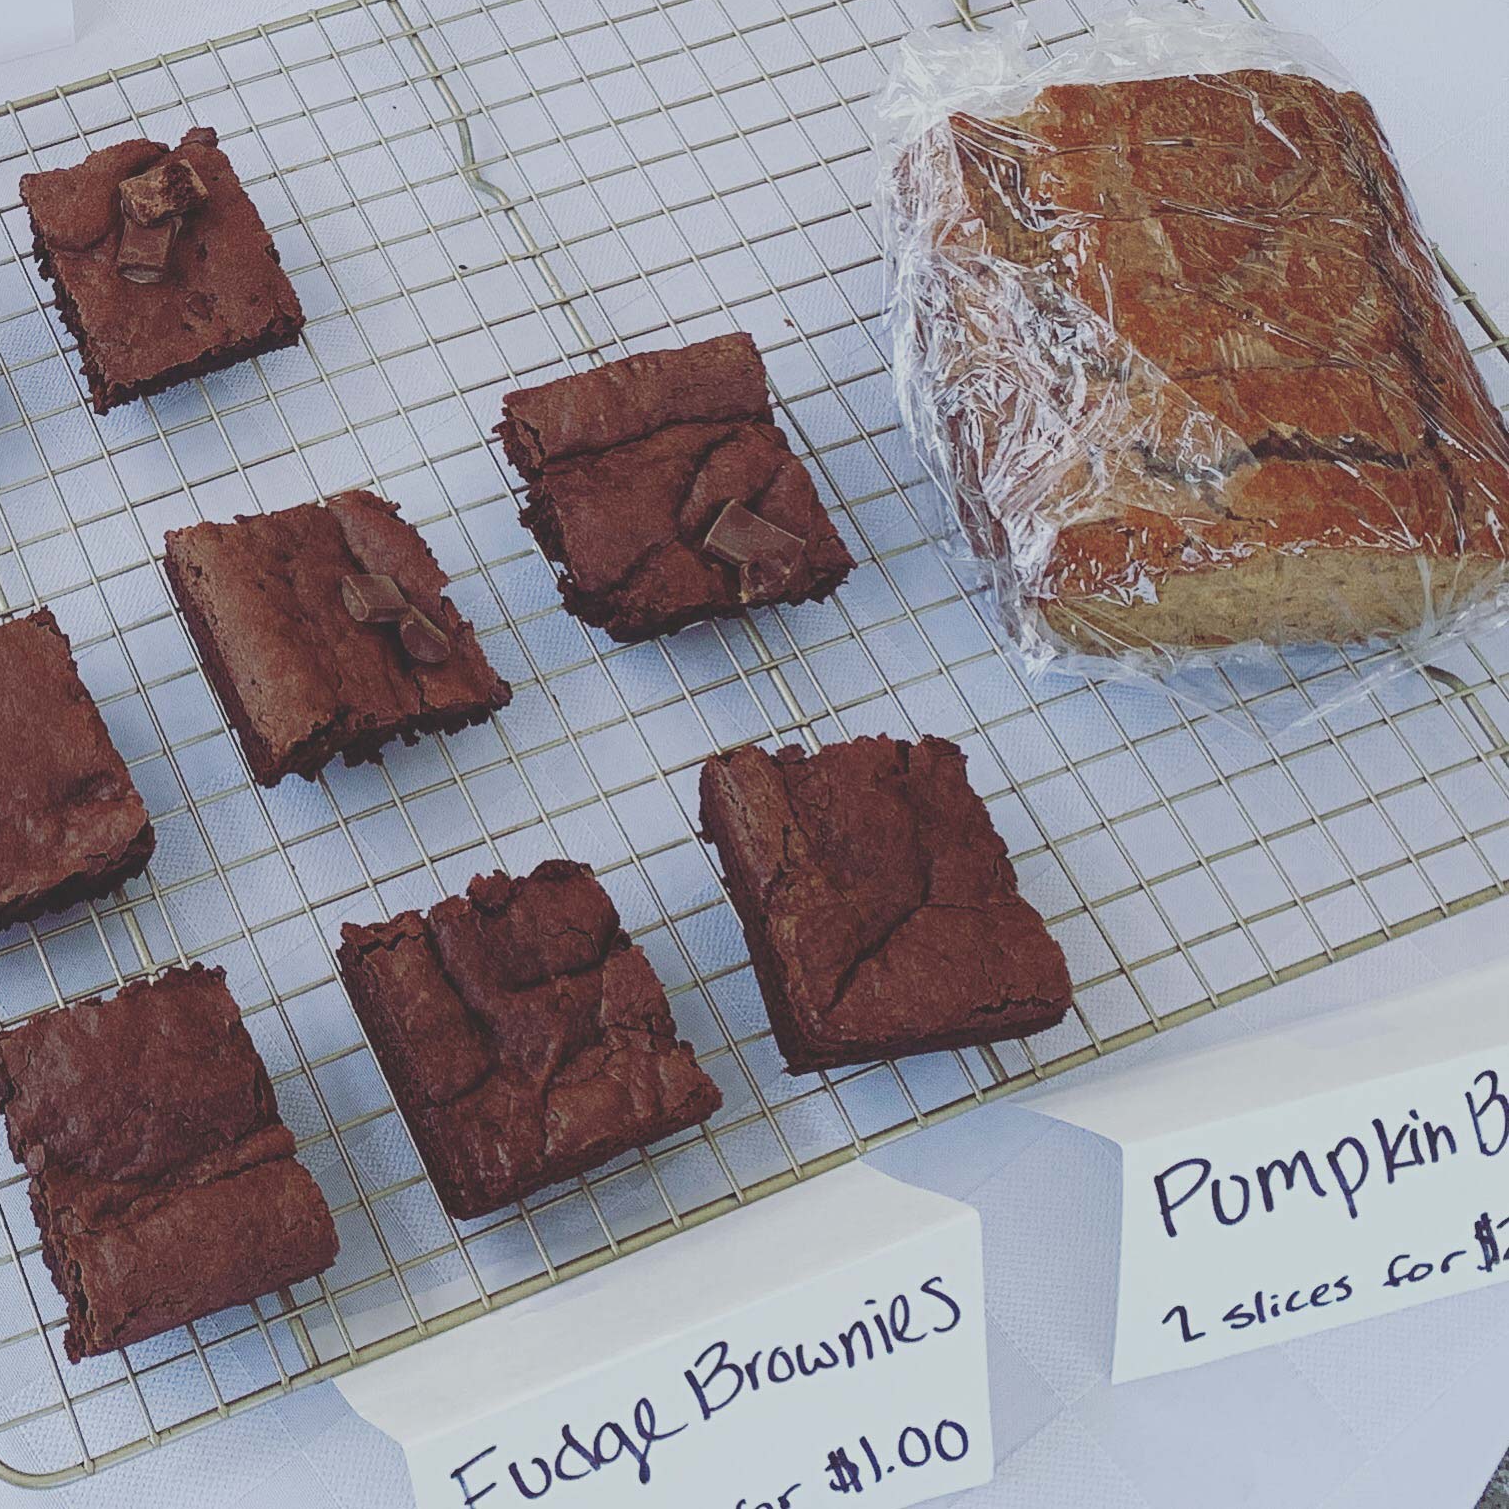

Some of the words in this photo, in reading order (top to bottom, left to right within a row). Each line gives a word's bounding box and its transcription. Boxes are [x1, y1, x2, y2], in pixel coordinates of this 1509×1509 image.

[1153, 1109, 1458, 1238] Pumpkin
[1161, 1305, 1206, 1343] 2
[1222, 1275, 1353, 1330] slices
[1383, 1250, 1467, 1288] for
[450, 1397, 689, 1509] Fudge
[683, 1276, 962, 1421] Brownies
[824, 1419, 969, 1494] $1.00
